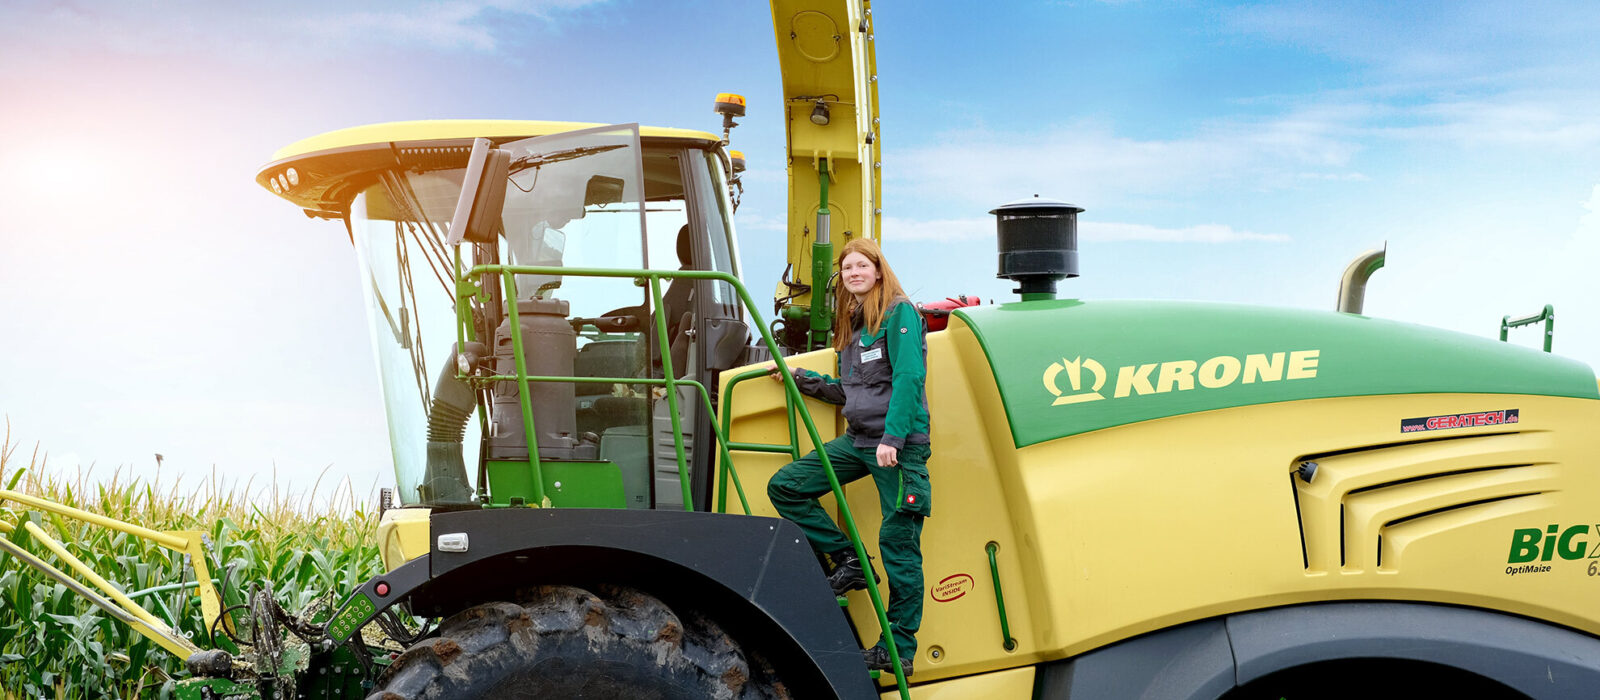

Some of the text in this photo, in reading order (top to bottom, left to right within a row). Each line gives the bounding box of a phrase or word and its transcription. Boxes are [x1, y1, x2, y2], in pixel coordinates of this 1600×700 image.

[1113, 350, 1320, 398] KRONE
[1507, 524, 1590, 564] BiG
[1505, 564, 1552, 576] OptiMaize
[936, 579, 967, 592] VariStream
[942, 587, 960, 597] INSIDE
